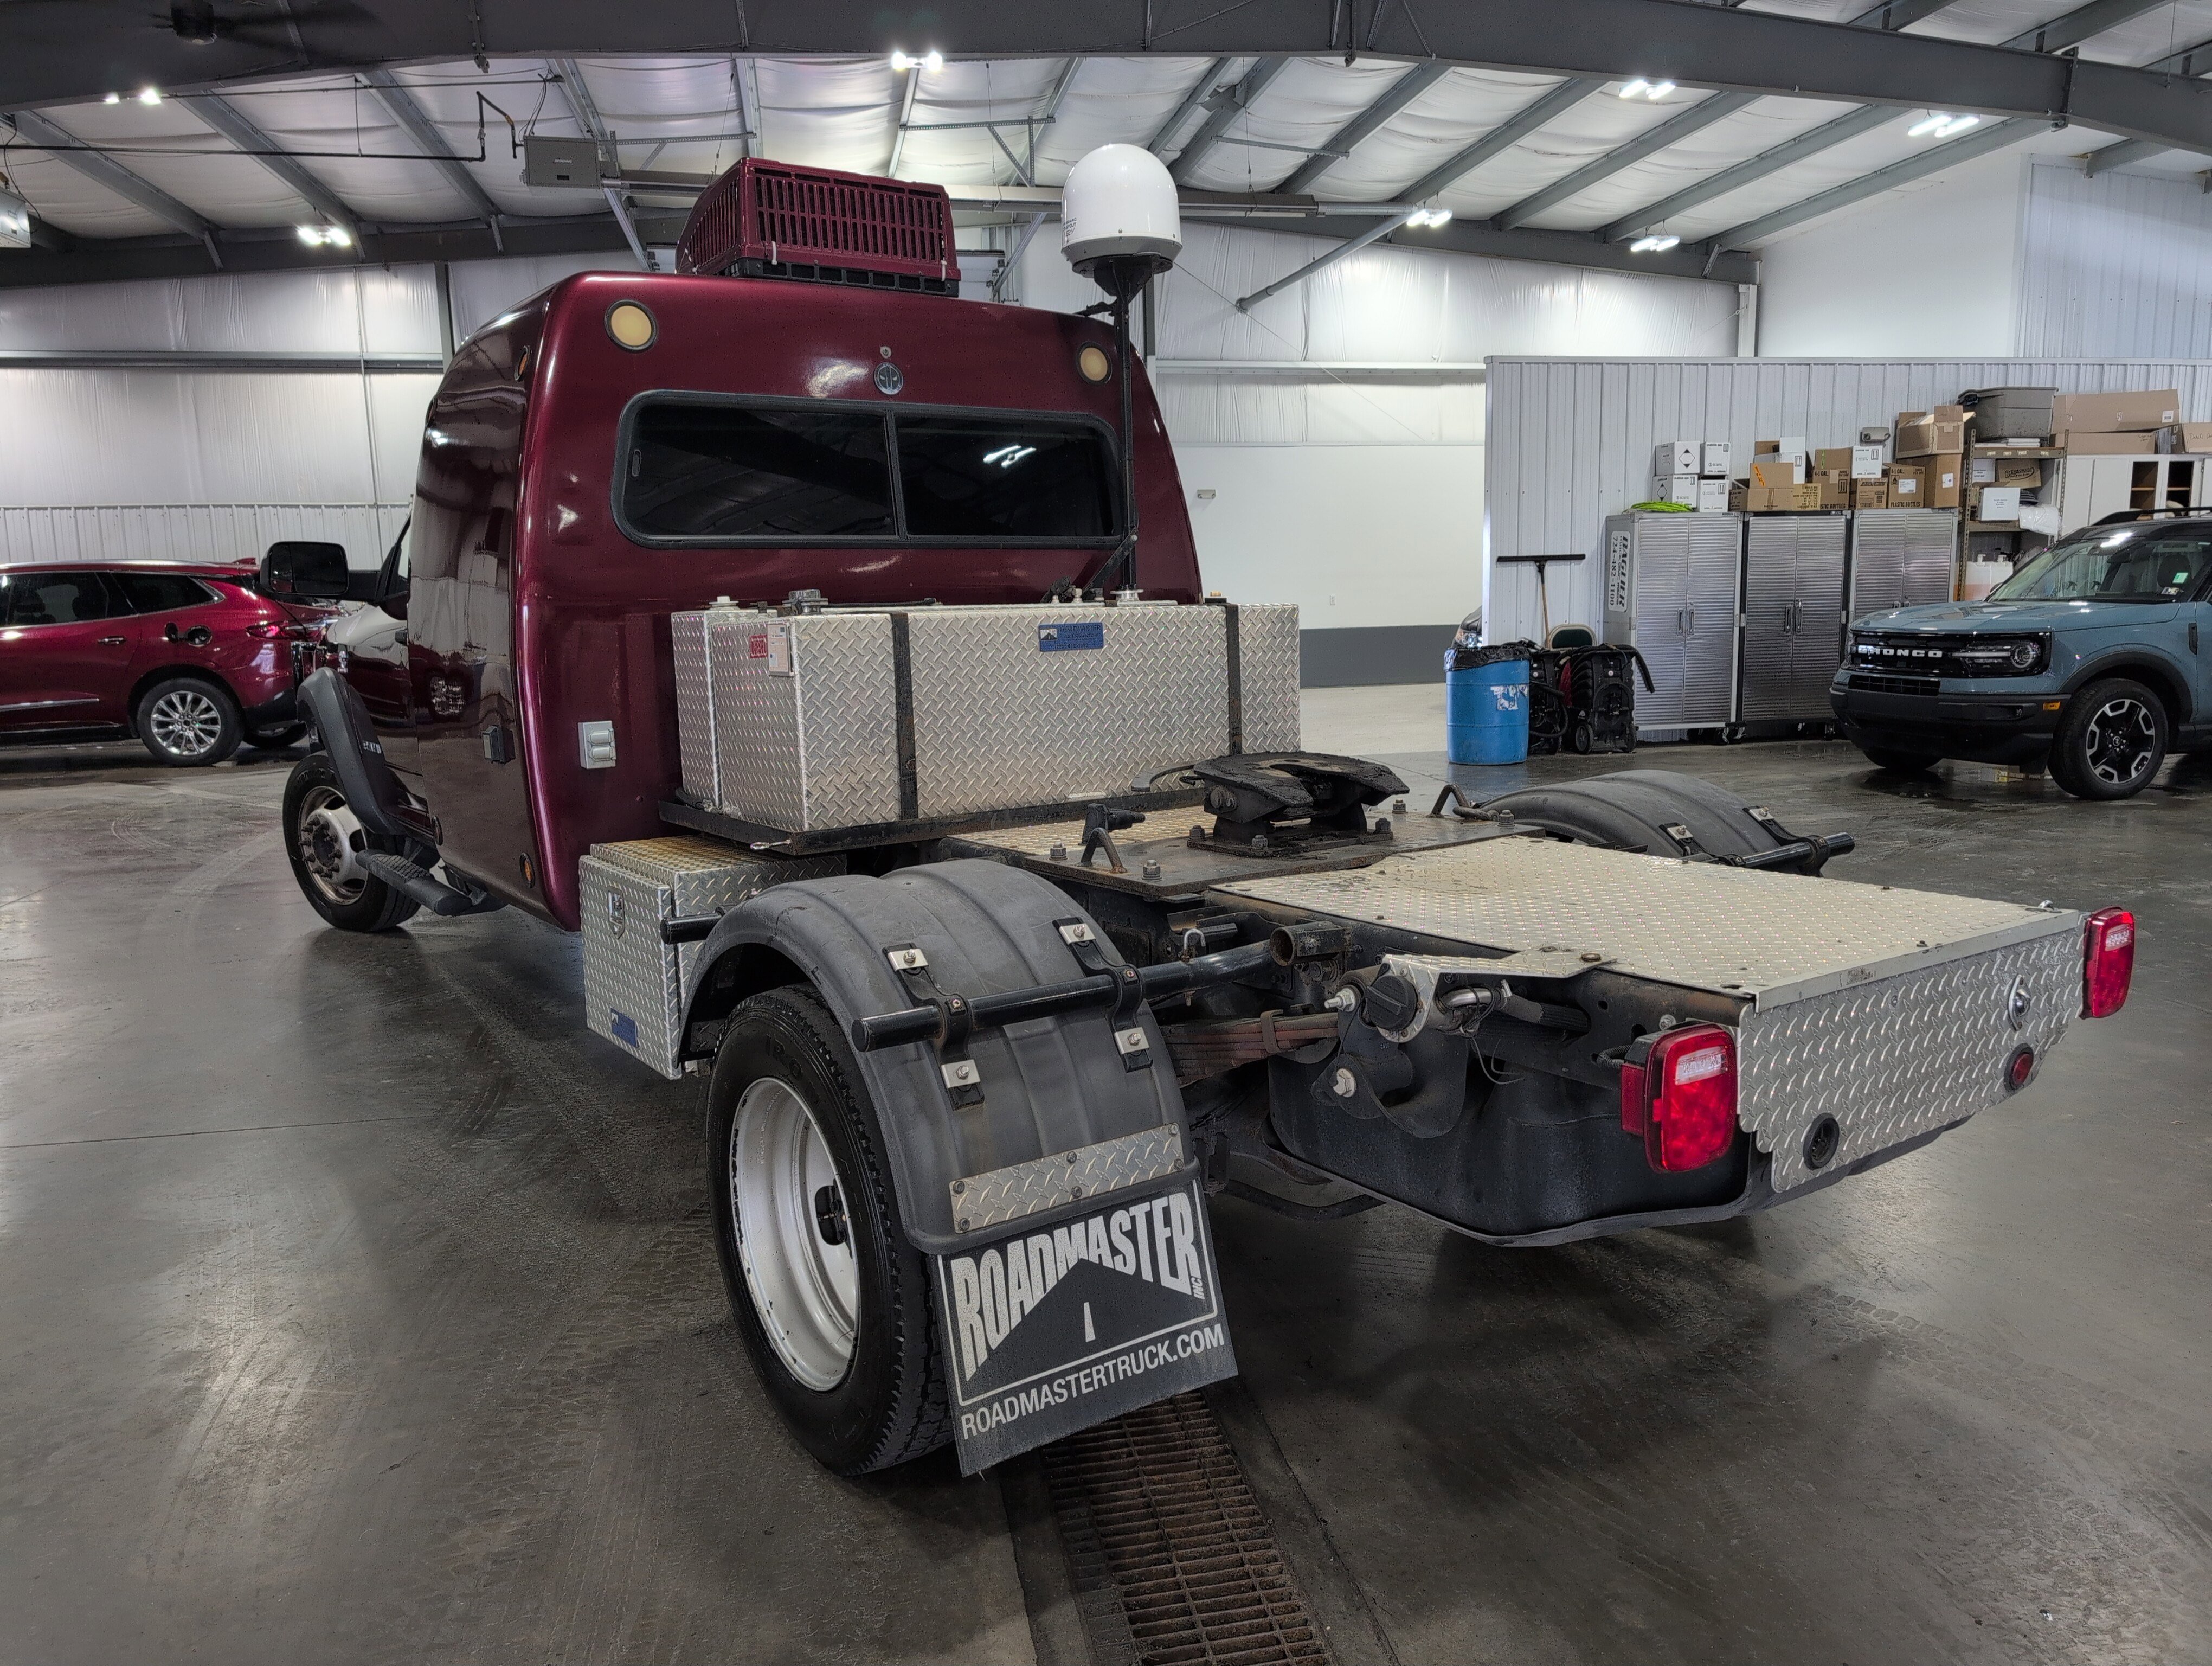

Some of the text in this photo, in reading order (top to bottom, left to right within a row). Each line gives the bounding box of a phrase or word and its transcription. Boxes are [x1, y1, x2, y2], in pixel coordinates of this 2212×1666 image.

[1610, 535, 1618, 606] 724-482-1100
[1619, 535, 1629, 607] BAGLIER
[1858, 645, 1943, 658] BRONCO
[950, 1192, 1201, 1381] ROADMASTER
[1191, 1277, 1205, 1300] INC
[961, 1323, 1225, 1440] ROADMASTERTRUCK.COM
